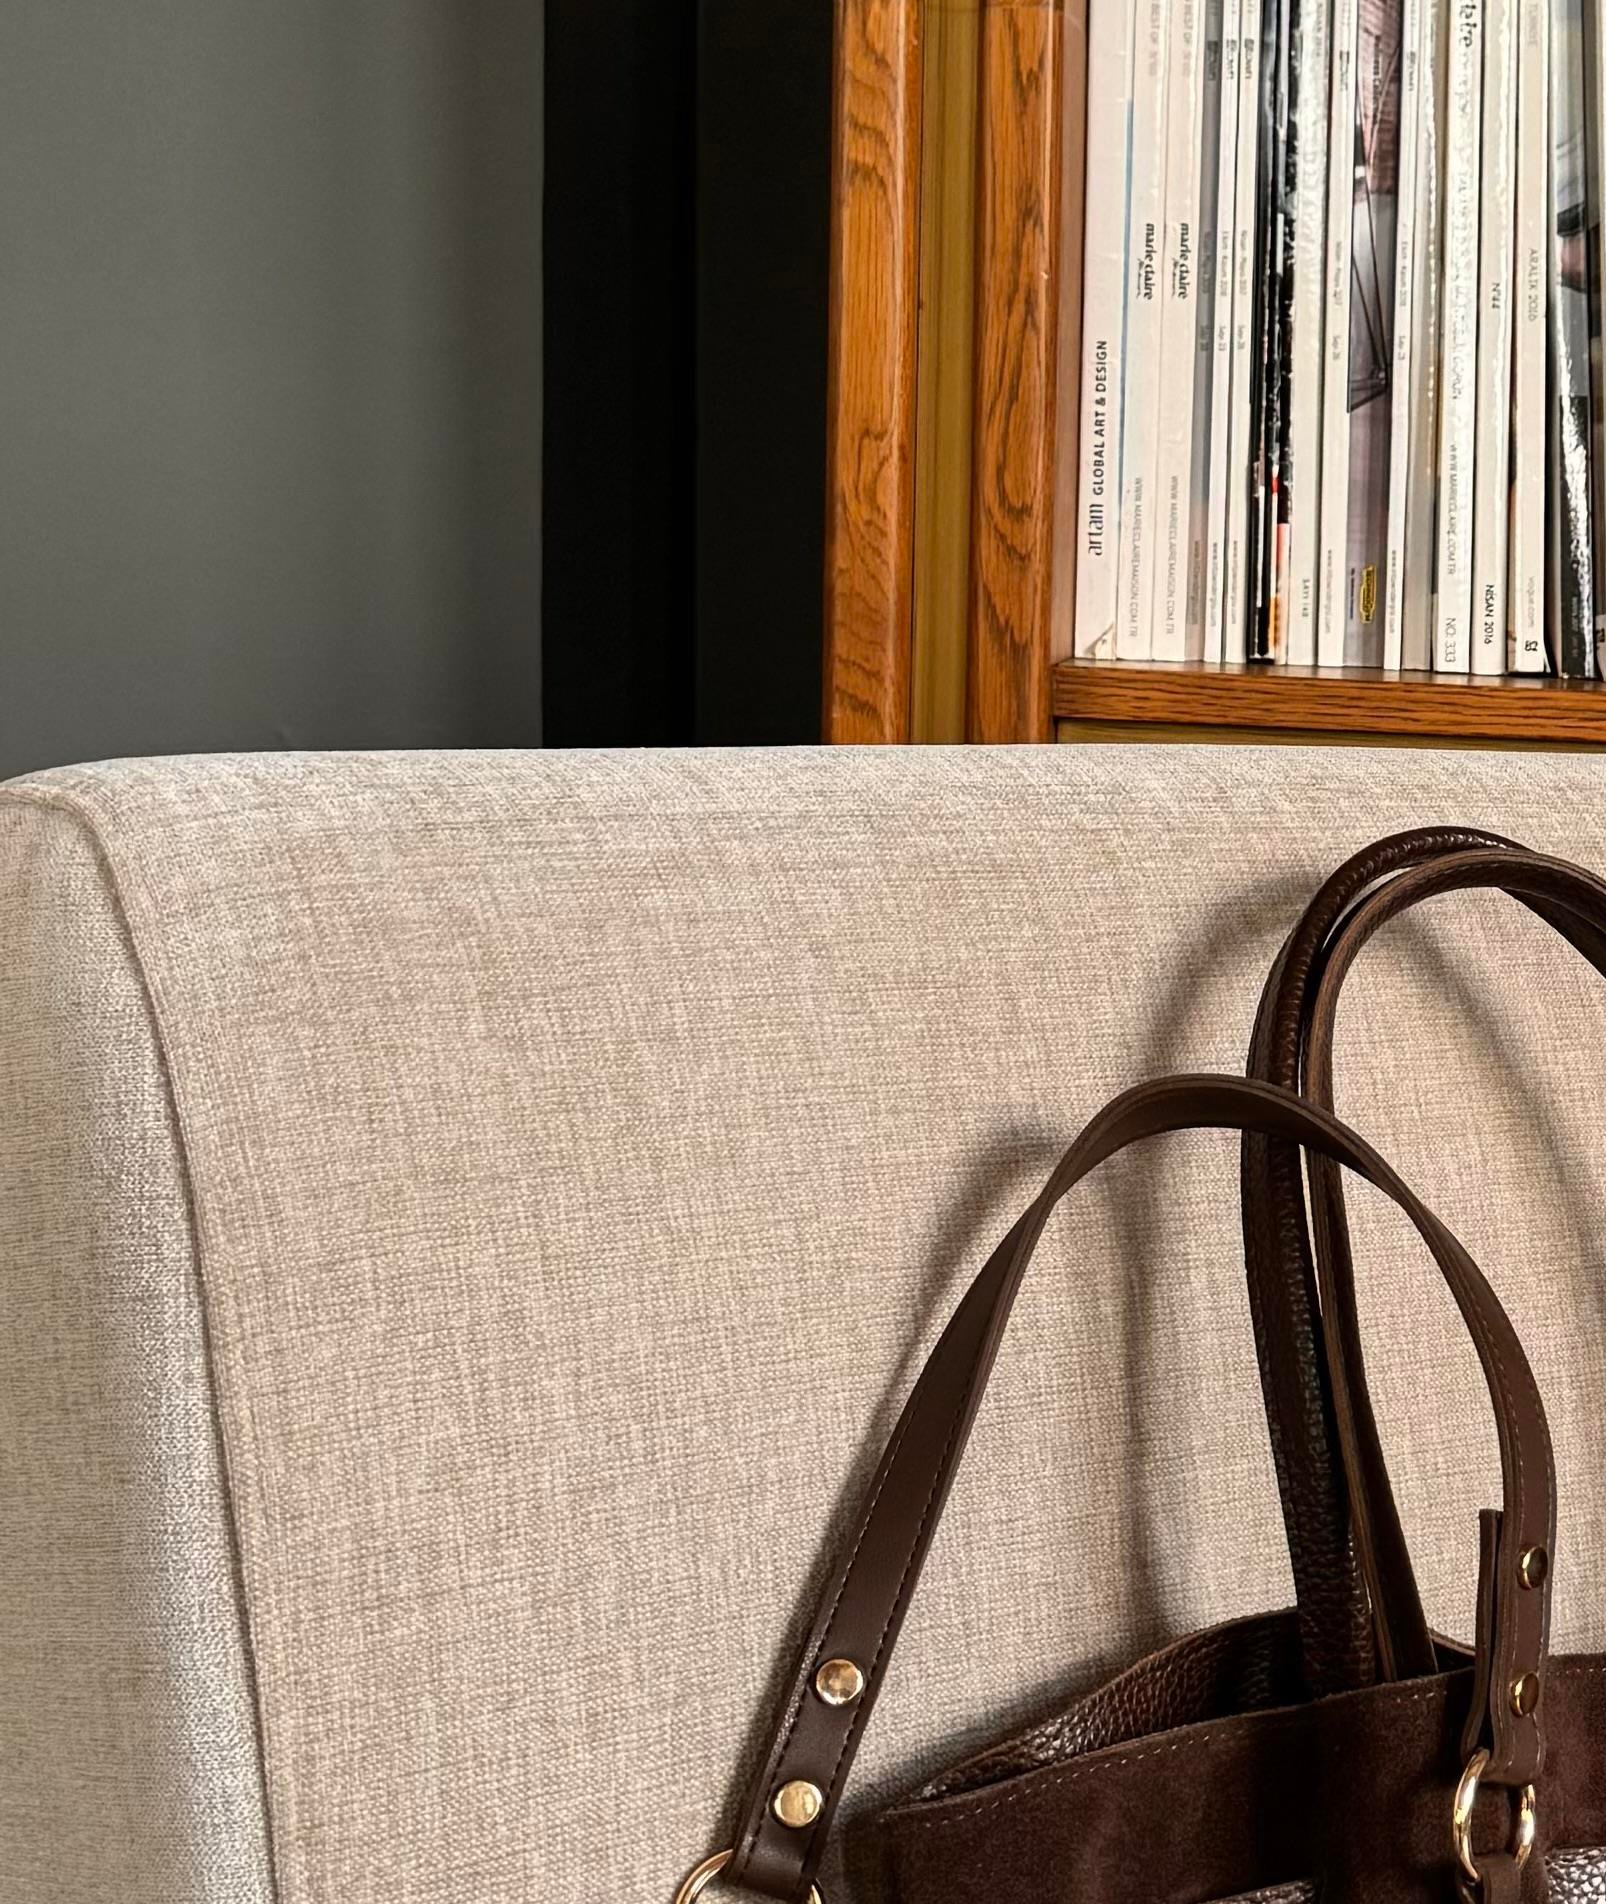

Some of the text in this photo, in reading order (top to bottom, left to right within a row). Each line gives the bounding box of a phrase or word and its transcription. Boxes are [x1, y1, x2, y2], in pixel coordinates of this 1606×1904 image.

[1144, 223, 1158, 301] marie claire
[1178, 222, 1192, 300] marie claire
[1527, 247, 1540, 322] ARALIK 2016
[1095, 339, 1108, 394] DESIGN
[1094, 411, 1106, 438] ART
[1095, 396, 1106, 407] &
[1092, 441, 1105, 496] GLOBAL
[1483, 584, 1497, 646] NİSAN 2016
[1443, 641, 1456, 664] 333
